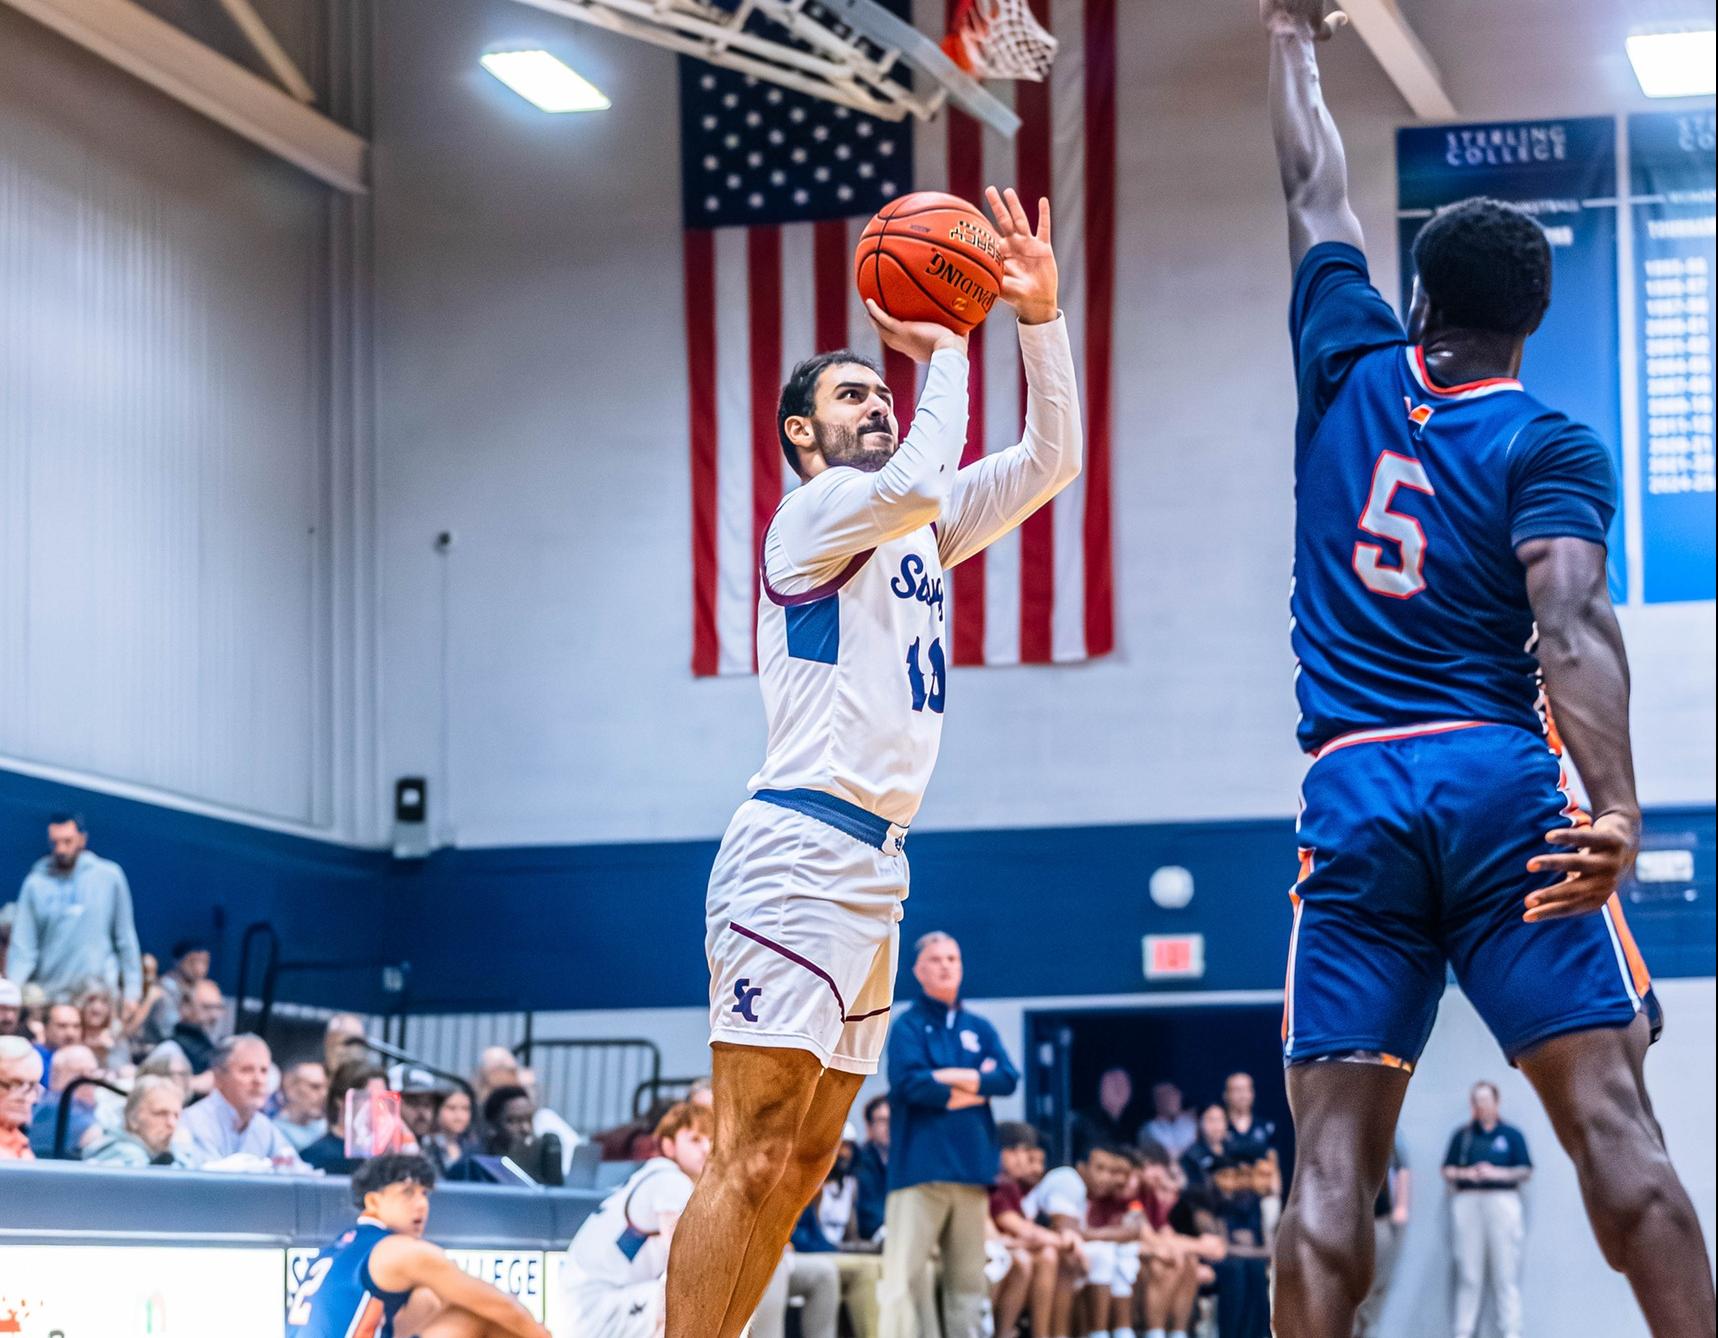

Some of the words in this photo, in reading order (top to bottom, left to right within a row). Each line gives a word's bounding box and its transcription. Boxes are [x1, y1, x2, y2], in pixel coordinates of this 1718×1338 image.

[1446, 143, 1565, 166] COLLEGE
[949, 228, 1002, 266] EGACY
[925, 252, 998, 314] PALDING
[1352, 449, 1435, 600] 5
